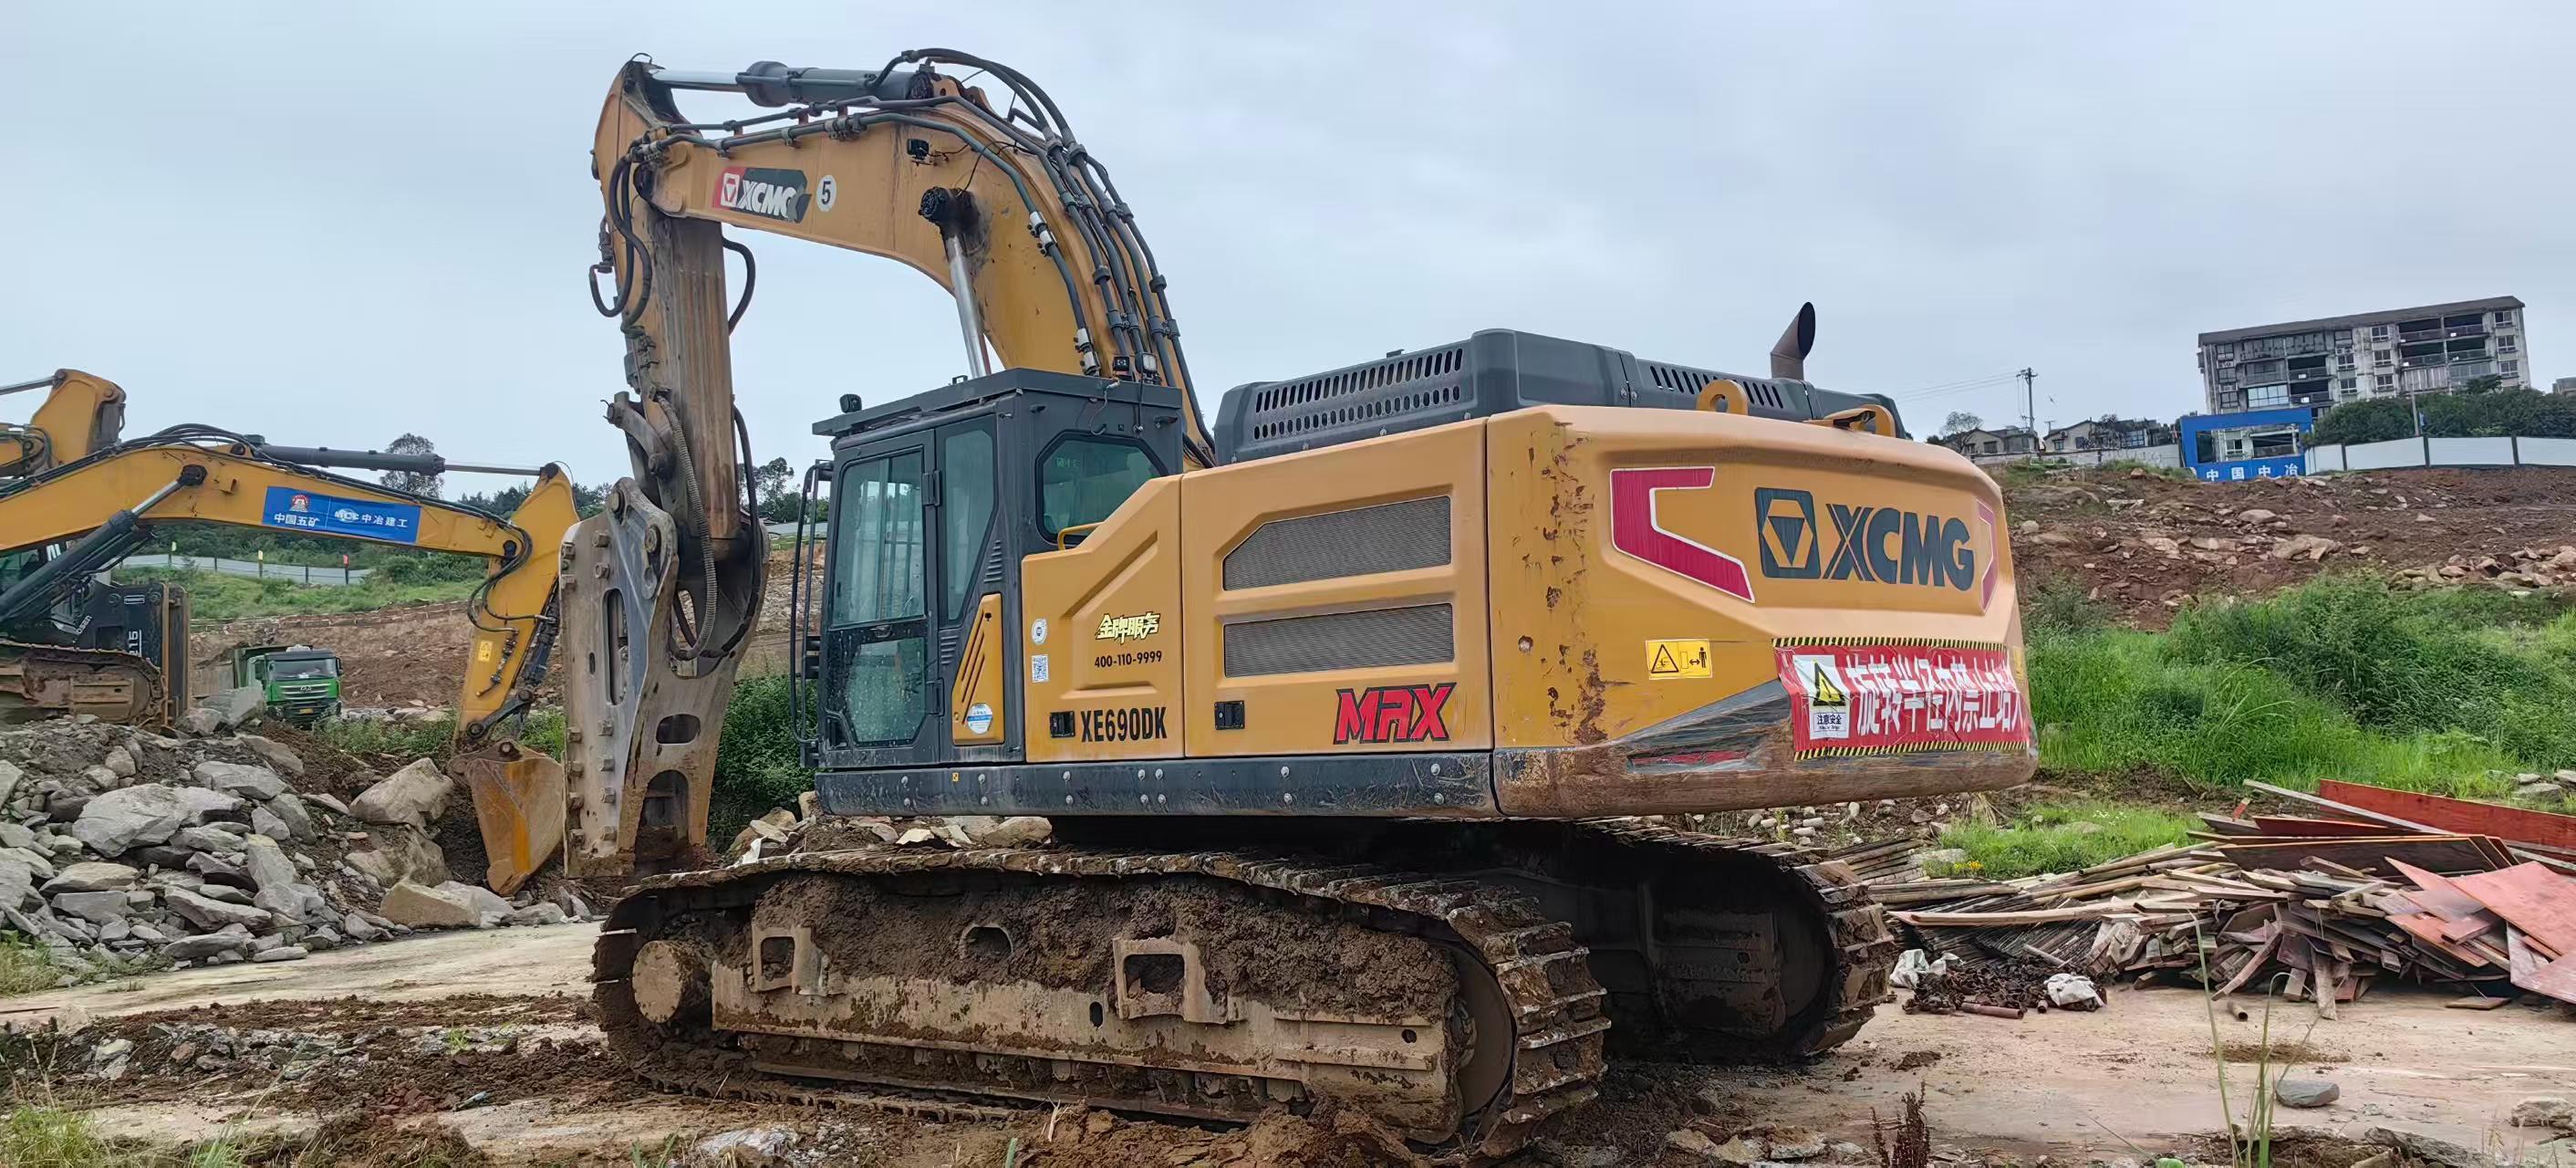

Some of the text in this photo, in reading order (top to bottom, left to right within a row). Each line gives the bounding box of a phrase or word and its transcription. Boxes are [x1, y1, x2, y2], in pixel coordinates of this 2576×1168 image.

[821, 181, 832, 205] 5
[2206, 464, 2299, 482] 中国中冶
[274, 512, 319, 527] 中国五矿
[361, 514, 409, 528] 中冶建工
[1823, 503, 1975, 591] XCMG
[1095, 610, 1161, 645] 金牌服务
[1095, 650, 1163, 668] 400-110-9999
[1080, 706, 1168, 743] XE690DK
[1333, 683, 1458, 745] MAX
[1816, 713, 1843, 725] 注意安全
